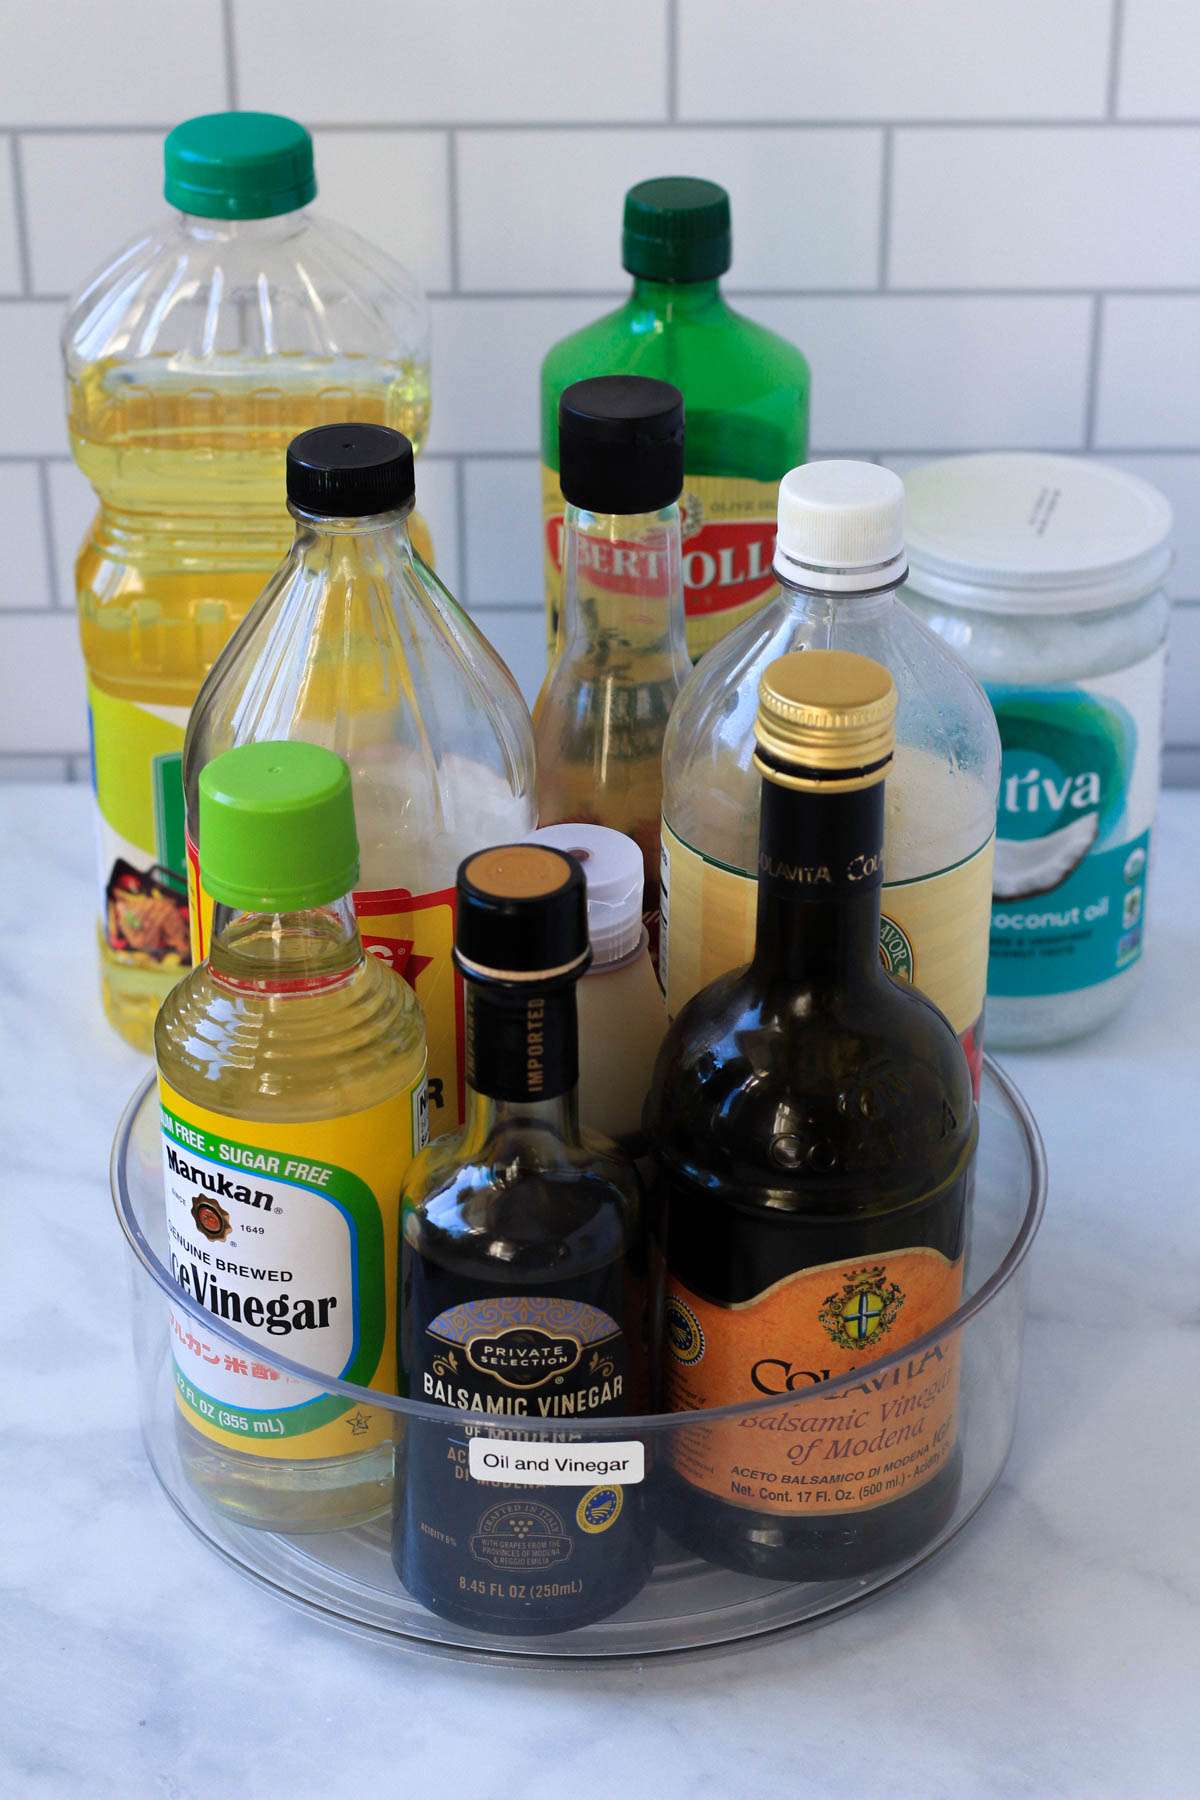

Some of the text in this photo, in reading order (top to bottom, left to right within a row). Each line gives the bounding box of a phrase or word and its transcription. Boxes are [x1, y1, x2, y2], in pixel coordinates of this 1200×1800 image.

[990, 896, 1109, 930] oconut oil
[880, 924, 908, 964] AVOR
[527, 998, 544, 1093] IMPORTED
[175, 1121, 207, 1153] FREE
[218, 1142, 281, 1175] SUGAR
[284, 1159, 334, 1188] FREE
[166, 1144, 275, 1212] Marukan
[240, 1224, 266, 1236] 1649
[215, 1258, 294, 1283] BREWED
[480, 1345, 569, 1368] PRIVATE SELECTION
[186, 1390, 198, 1408] FL
[199, 1399, 215, 1419] OZ
[218, 1411, 249, 1432] (355
[252, 1418, 285, 1435] mL)
[423, 1371, 528, 1418] BALSAMIC
[537, 1375, 624, 1418] VINEGAR
[737, 1407, 870, 1433] Balsamic
[786, 1438, 823, 1466] of
[823, 1416, 924, 1460] Modena
[483, 1453, 630, 1475] Oil and Vinegar
[730, 1465, 778, 1483] ACETO
[780, 1470, 866, 1486] BALSAMICO
[867, 1466, 882, 1478] DI
[883, 1444, 930, 1473] MODENA
[730, 1480, 756, 1499] Net.
[759, 1484, 793, 1503] Cont.
[796, 1491, 813, 1504] 17
[834, 1488, 856, 1501] Oz.
[458, 1575, 584, 1600] 8.45 FL OZ (250mL)
